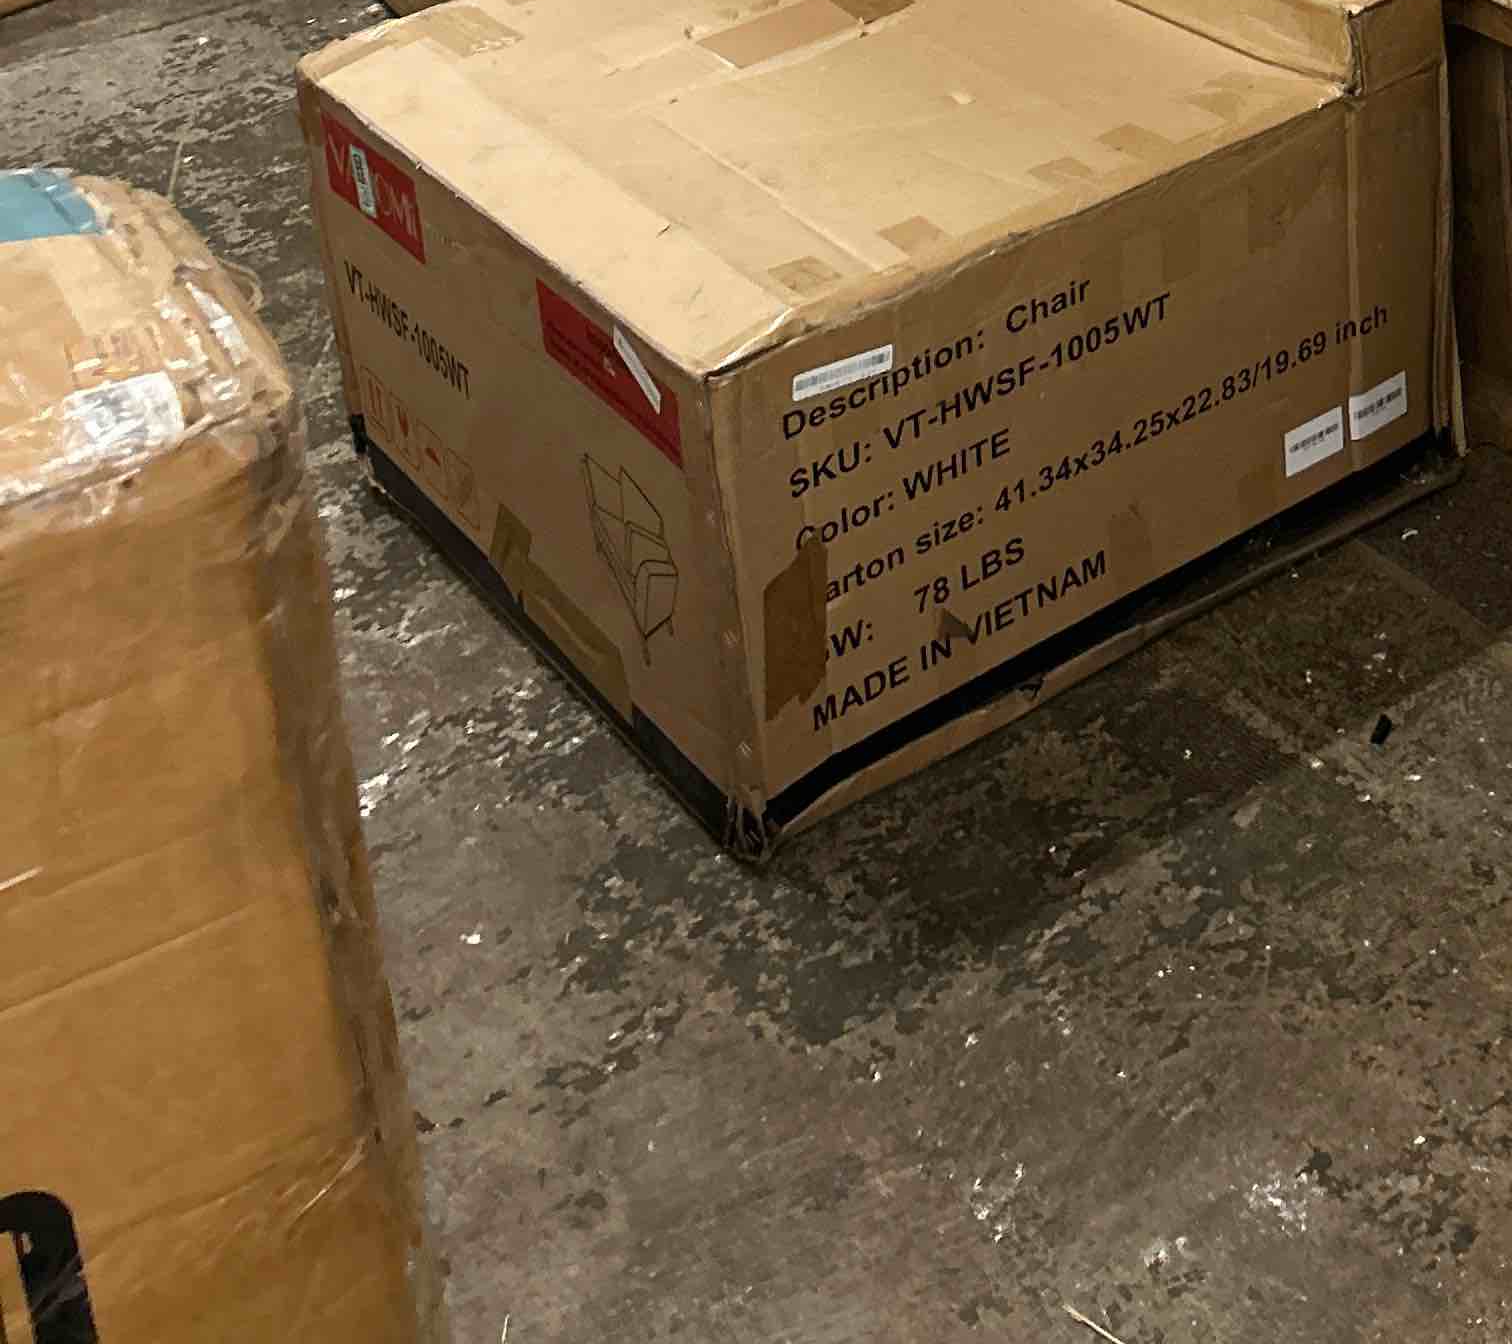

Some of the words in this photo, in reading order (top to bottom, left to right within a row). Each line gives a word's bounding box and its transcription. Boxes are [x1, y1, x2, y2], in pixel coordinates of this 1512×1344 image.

[344, 260, 470, 400] VT-HWSF-1005WT
[783, 327, 987, 440] Description:
[1005, 276, 1092, 334] Chair
[789, 437, 874, 499] SKU:
[881, 292, 1171, 453] VT-HWSF-1005WT
[825, 544, 906, 604] arton
[914, 503, 986, 557] size:
[994, 333, 1328, 514] 41.34x34.25x22.83/19.69
[1334, 304, 1390, 346] inch
[902, 427, 1012, 500] WHITE
[810, 658, 911, 730] MADE
[920, 633, 955, 671] IN
[965, 550, 1109, 647] VIETNAM
[826, 620, 875, 662] W:
[913, 576, 950, 615] 78
[961, 537, 1027, 593] LBS
